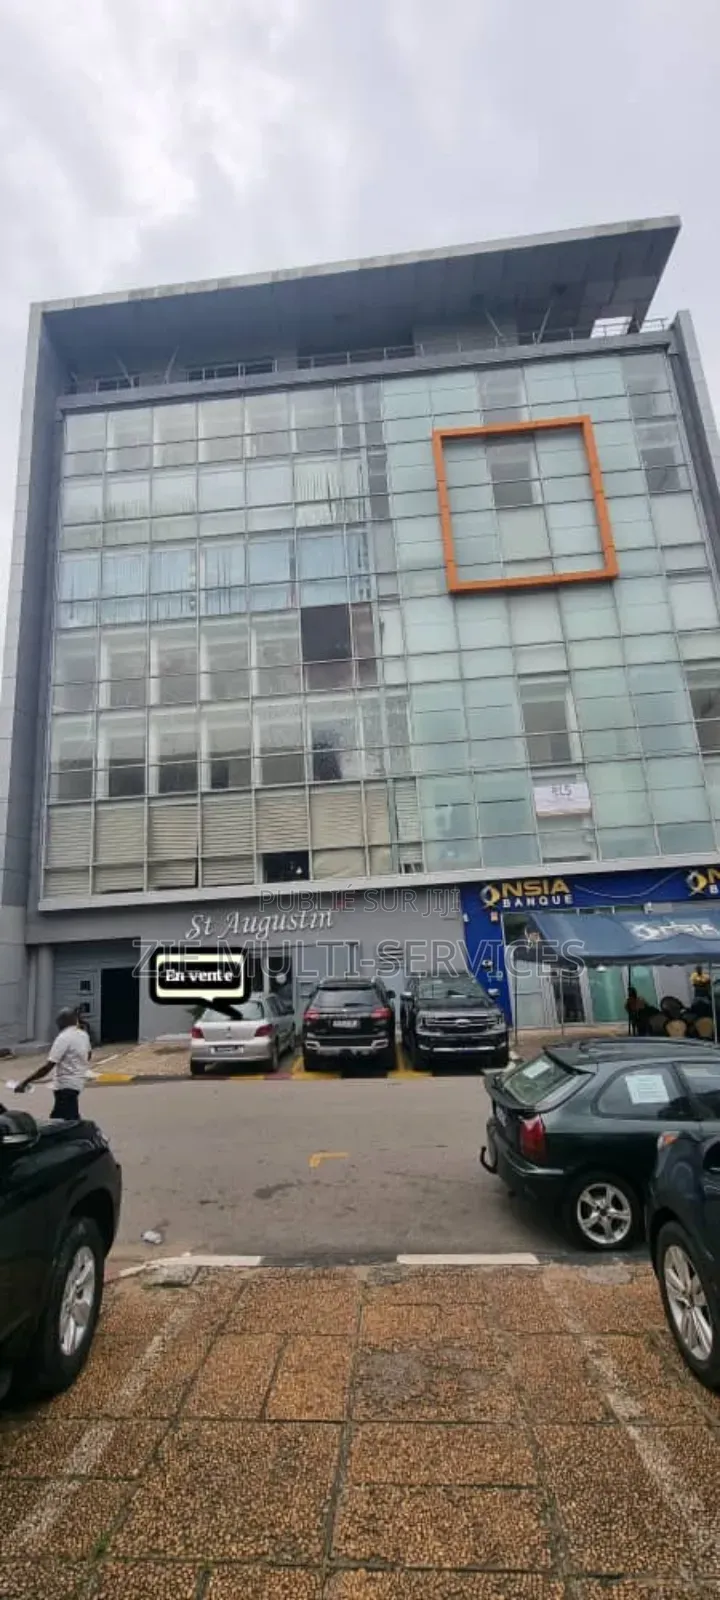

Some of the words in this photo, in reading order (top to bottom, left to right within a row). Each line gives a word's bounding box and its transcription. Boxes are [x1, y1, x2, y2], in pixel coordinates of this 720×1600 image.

[502, 879, 570, 898] NSIA
[502, 894, 573, 908] BANQUE
[186, 914, 213, 939] St
[218, 906, 334, 940] Augustin
